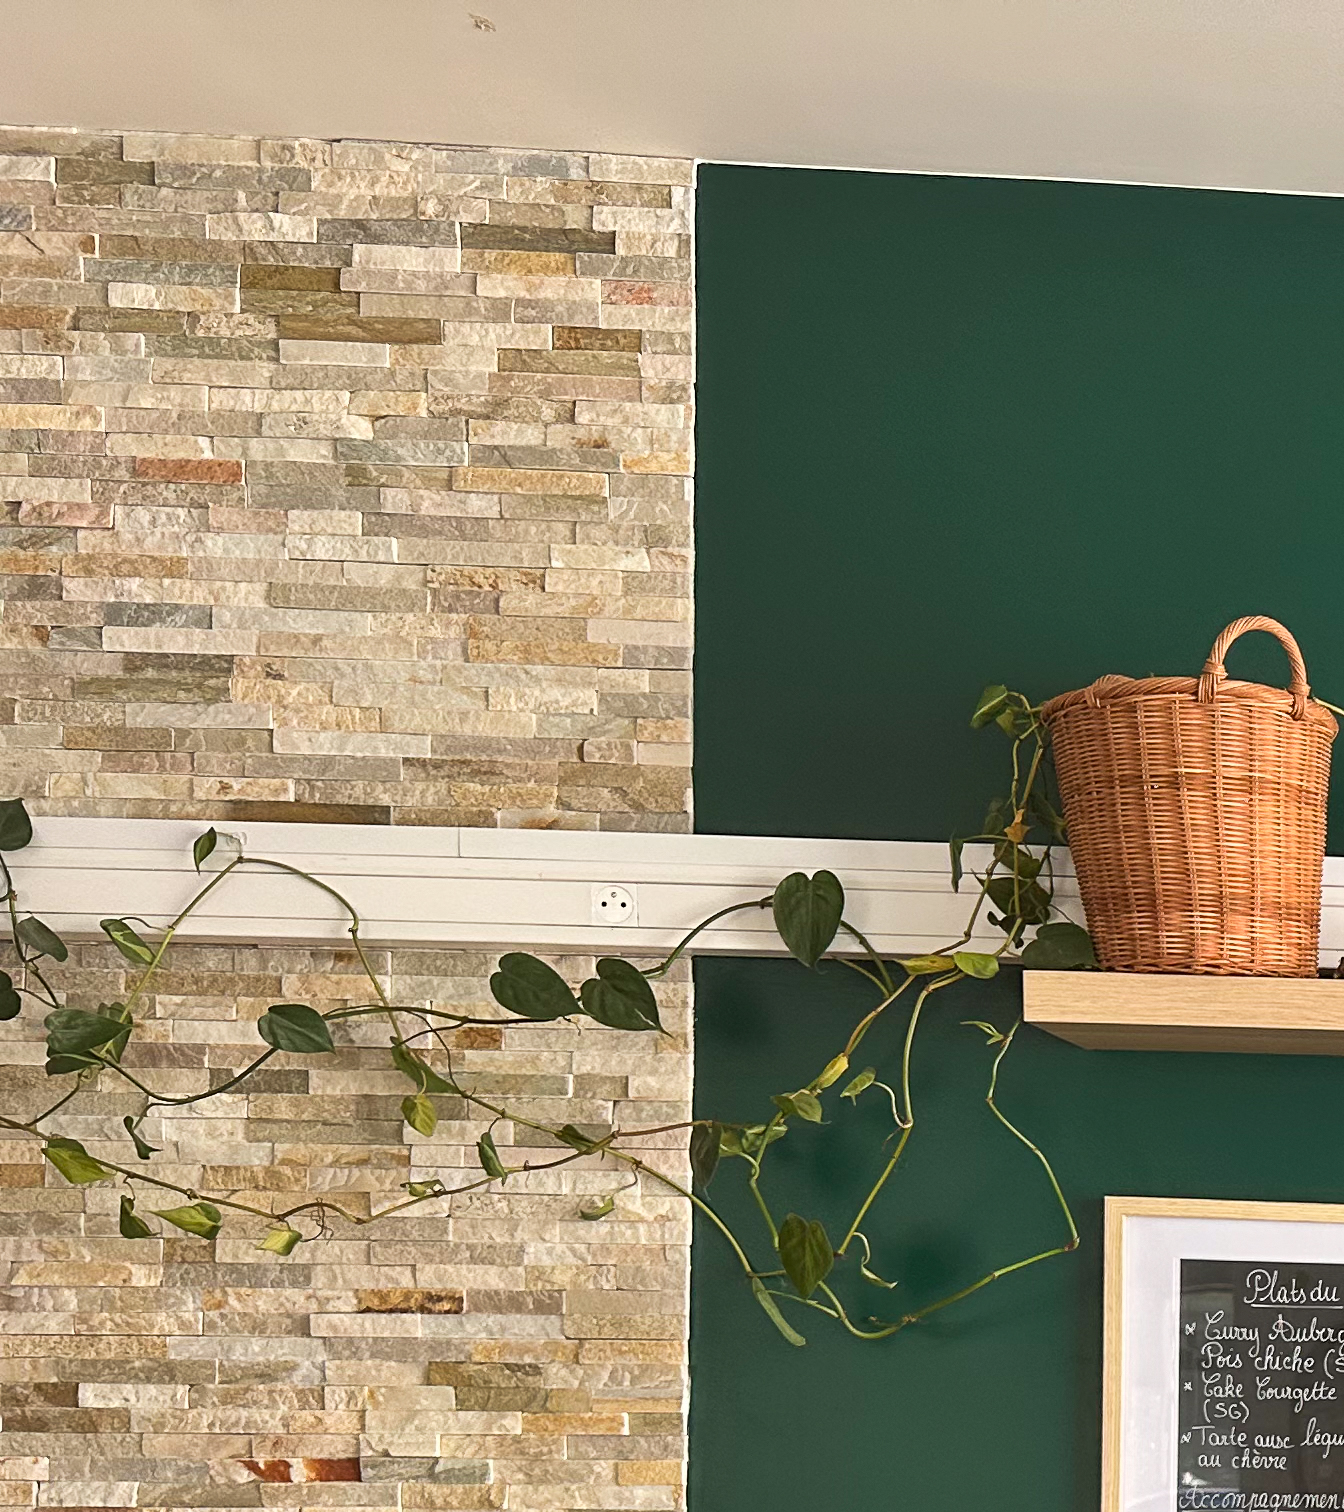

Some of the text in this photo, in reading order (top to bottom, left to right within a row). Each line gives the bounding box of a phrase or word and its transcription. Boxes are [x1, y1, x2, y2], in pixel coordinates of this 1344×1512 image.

[1244, 1269, 1306, 1304] Plats
[1310, 1280, 1341, 1302] du
[1205, 1310, 1260, 1357] Curry
[1201, 1342, 1243, 1369] Pois
[1254, 1346, 1315, 1373] chiche
[1201, 1371, 1245, 1398] Cake
[1256, 1376, 1338, 1413] Courgette
[1202, 1399, 1250, 1424] (SG)
[1191, 1425, 1249, 1447] Tarte
[1198, 1448, 1288, 1471] au chèvre
